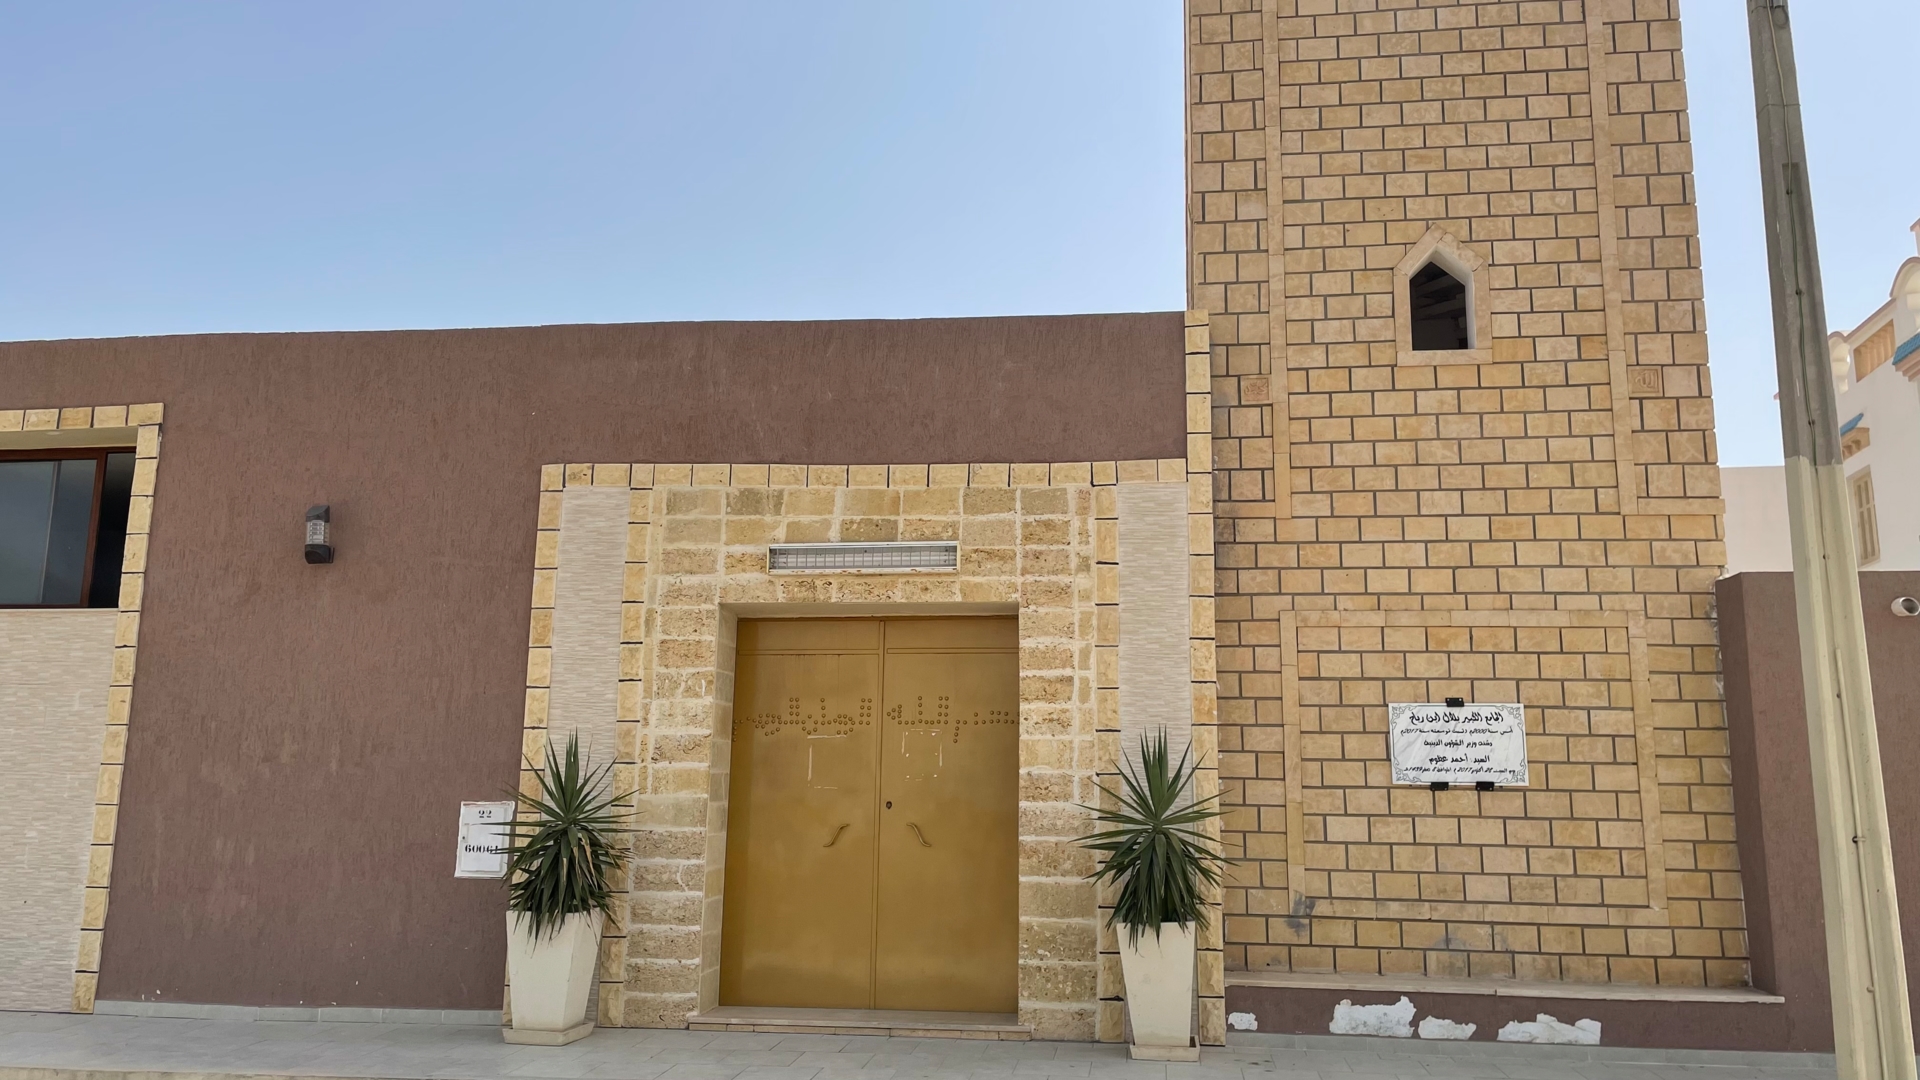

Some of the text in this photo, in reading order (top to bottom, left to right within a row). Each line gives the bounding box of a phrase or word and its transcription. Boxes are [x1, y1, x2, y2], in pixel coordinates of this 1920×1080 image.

[1409, 711, 1504, 726] الجامع الكبير بلال ابن رباح
[478, 809, 492, 819] 22
